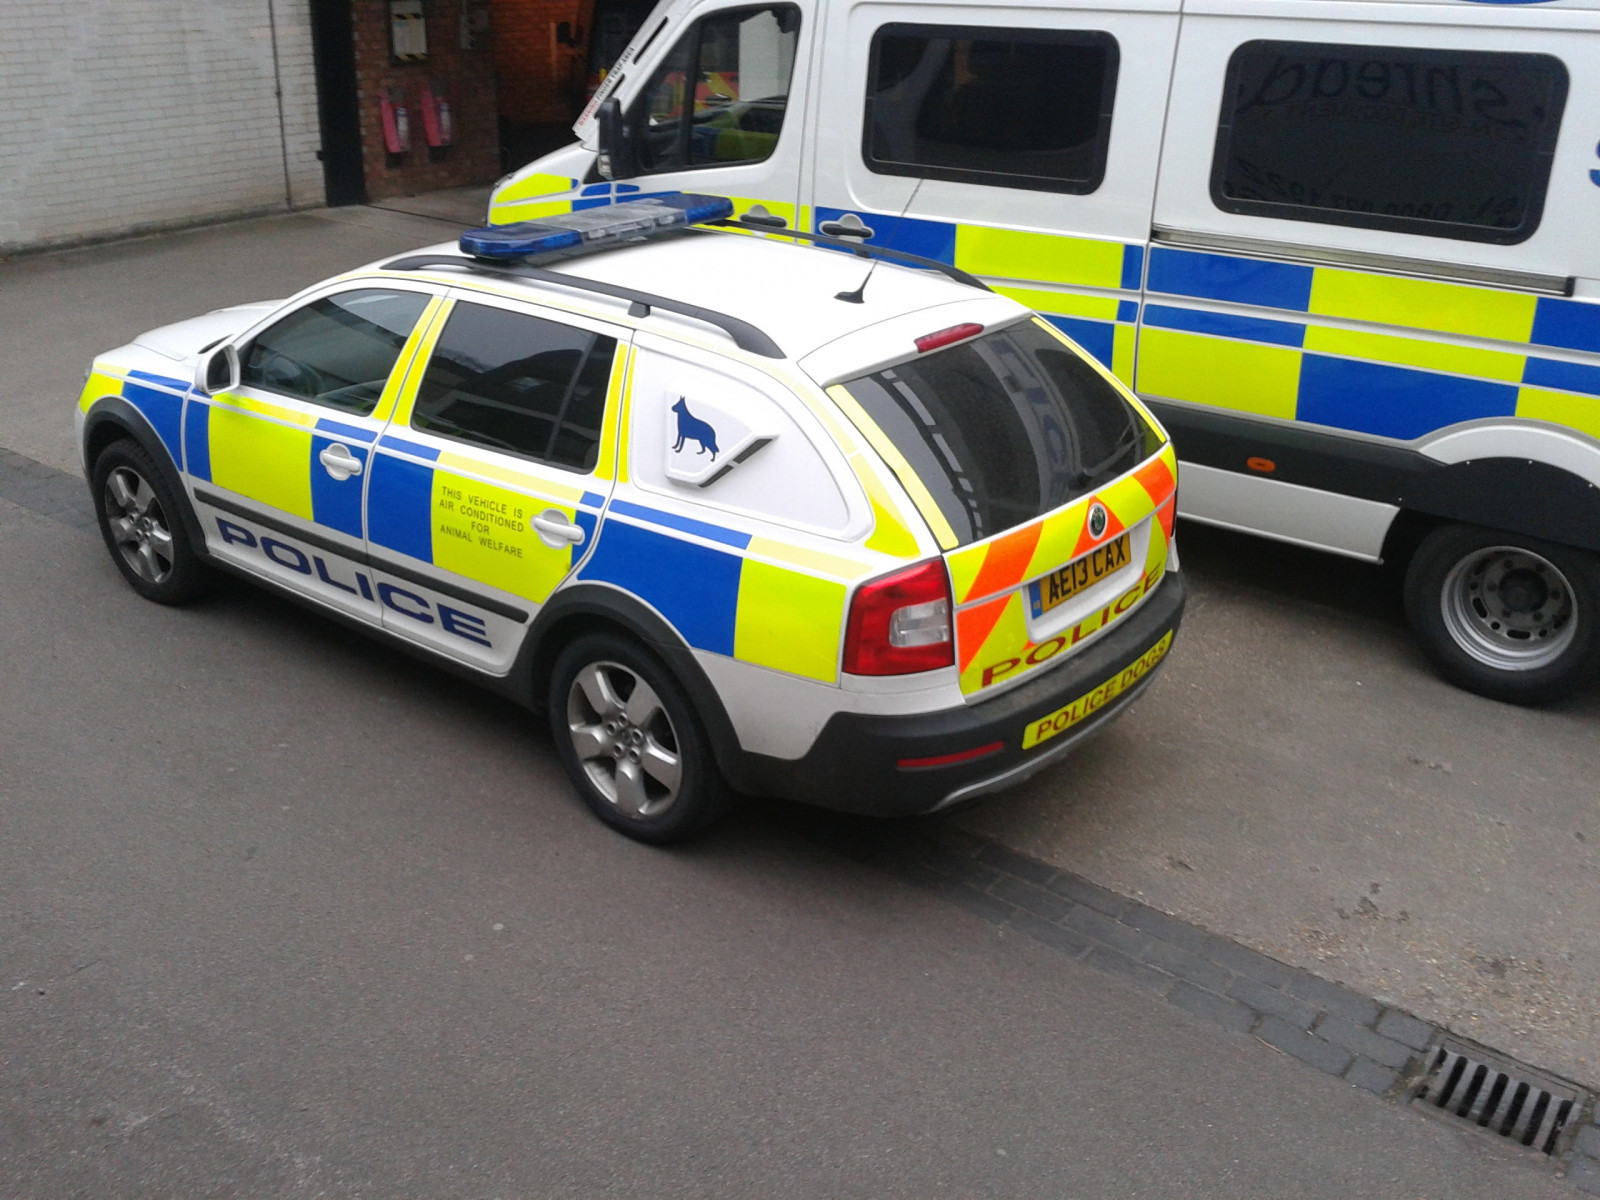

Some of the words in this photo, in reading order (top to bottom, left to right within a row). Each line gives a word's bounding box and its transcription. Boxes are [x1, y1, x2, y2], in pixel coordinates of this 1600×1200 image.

[439, 499, 454, 511] AIR
[460, 505, 524, 532] CONDITIONED
[442, 486, 462, 500] THIS
[468, 494, 508, 514] VEHICLE
[514, 508, 523, 519] IS
[471, 521, 490, 535] FOR
[440, 524, 472, 542] ANIMAL
[479, 537, 523, 558] WELFARE
[215, 516, 492, 648] POLICE
[1049, 557, 1089, 605] AE13
[1093, 536, 1126, 577] CAX
[981, 562, 1161, 688] POLICE
[1037, 681, 1117, 740] POLICE
[1121, 638, 1166, 688] DOGS
